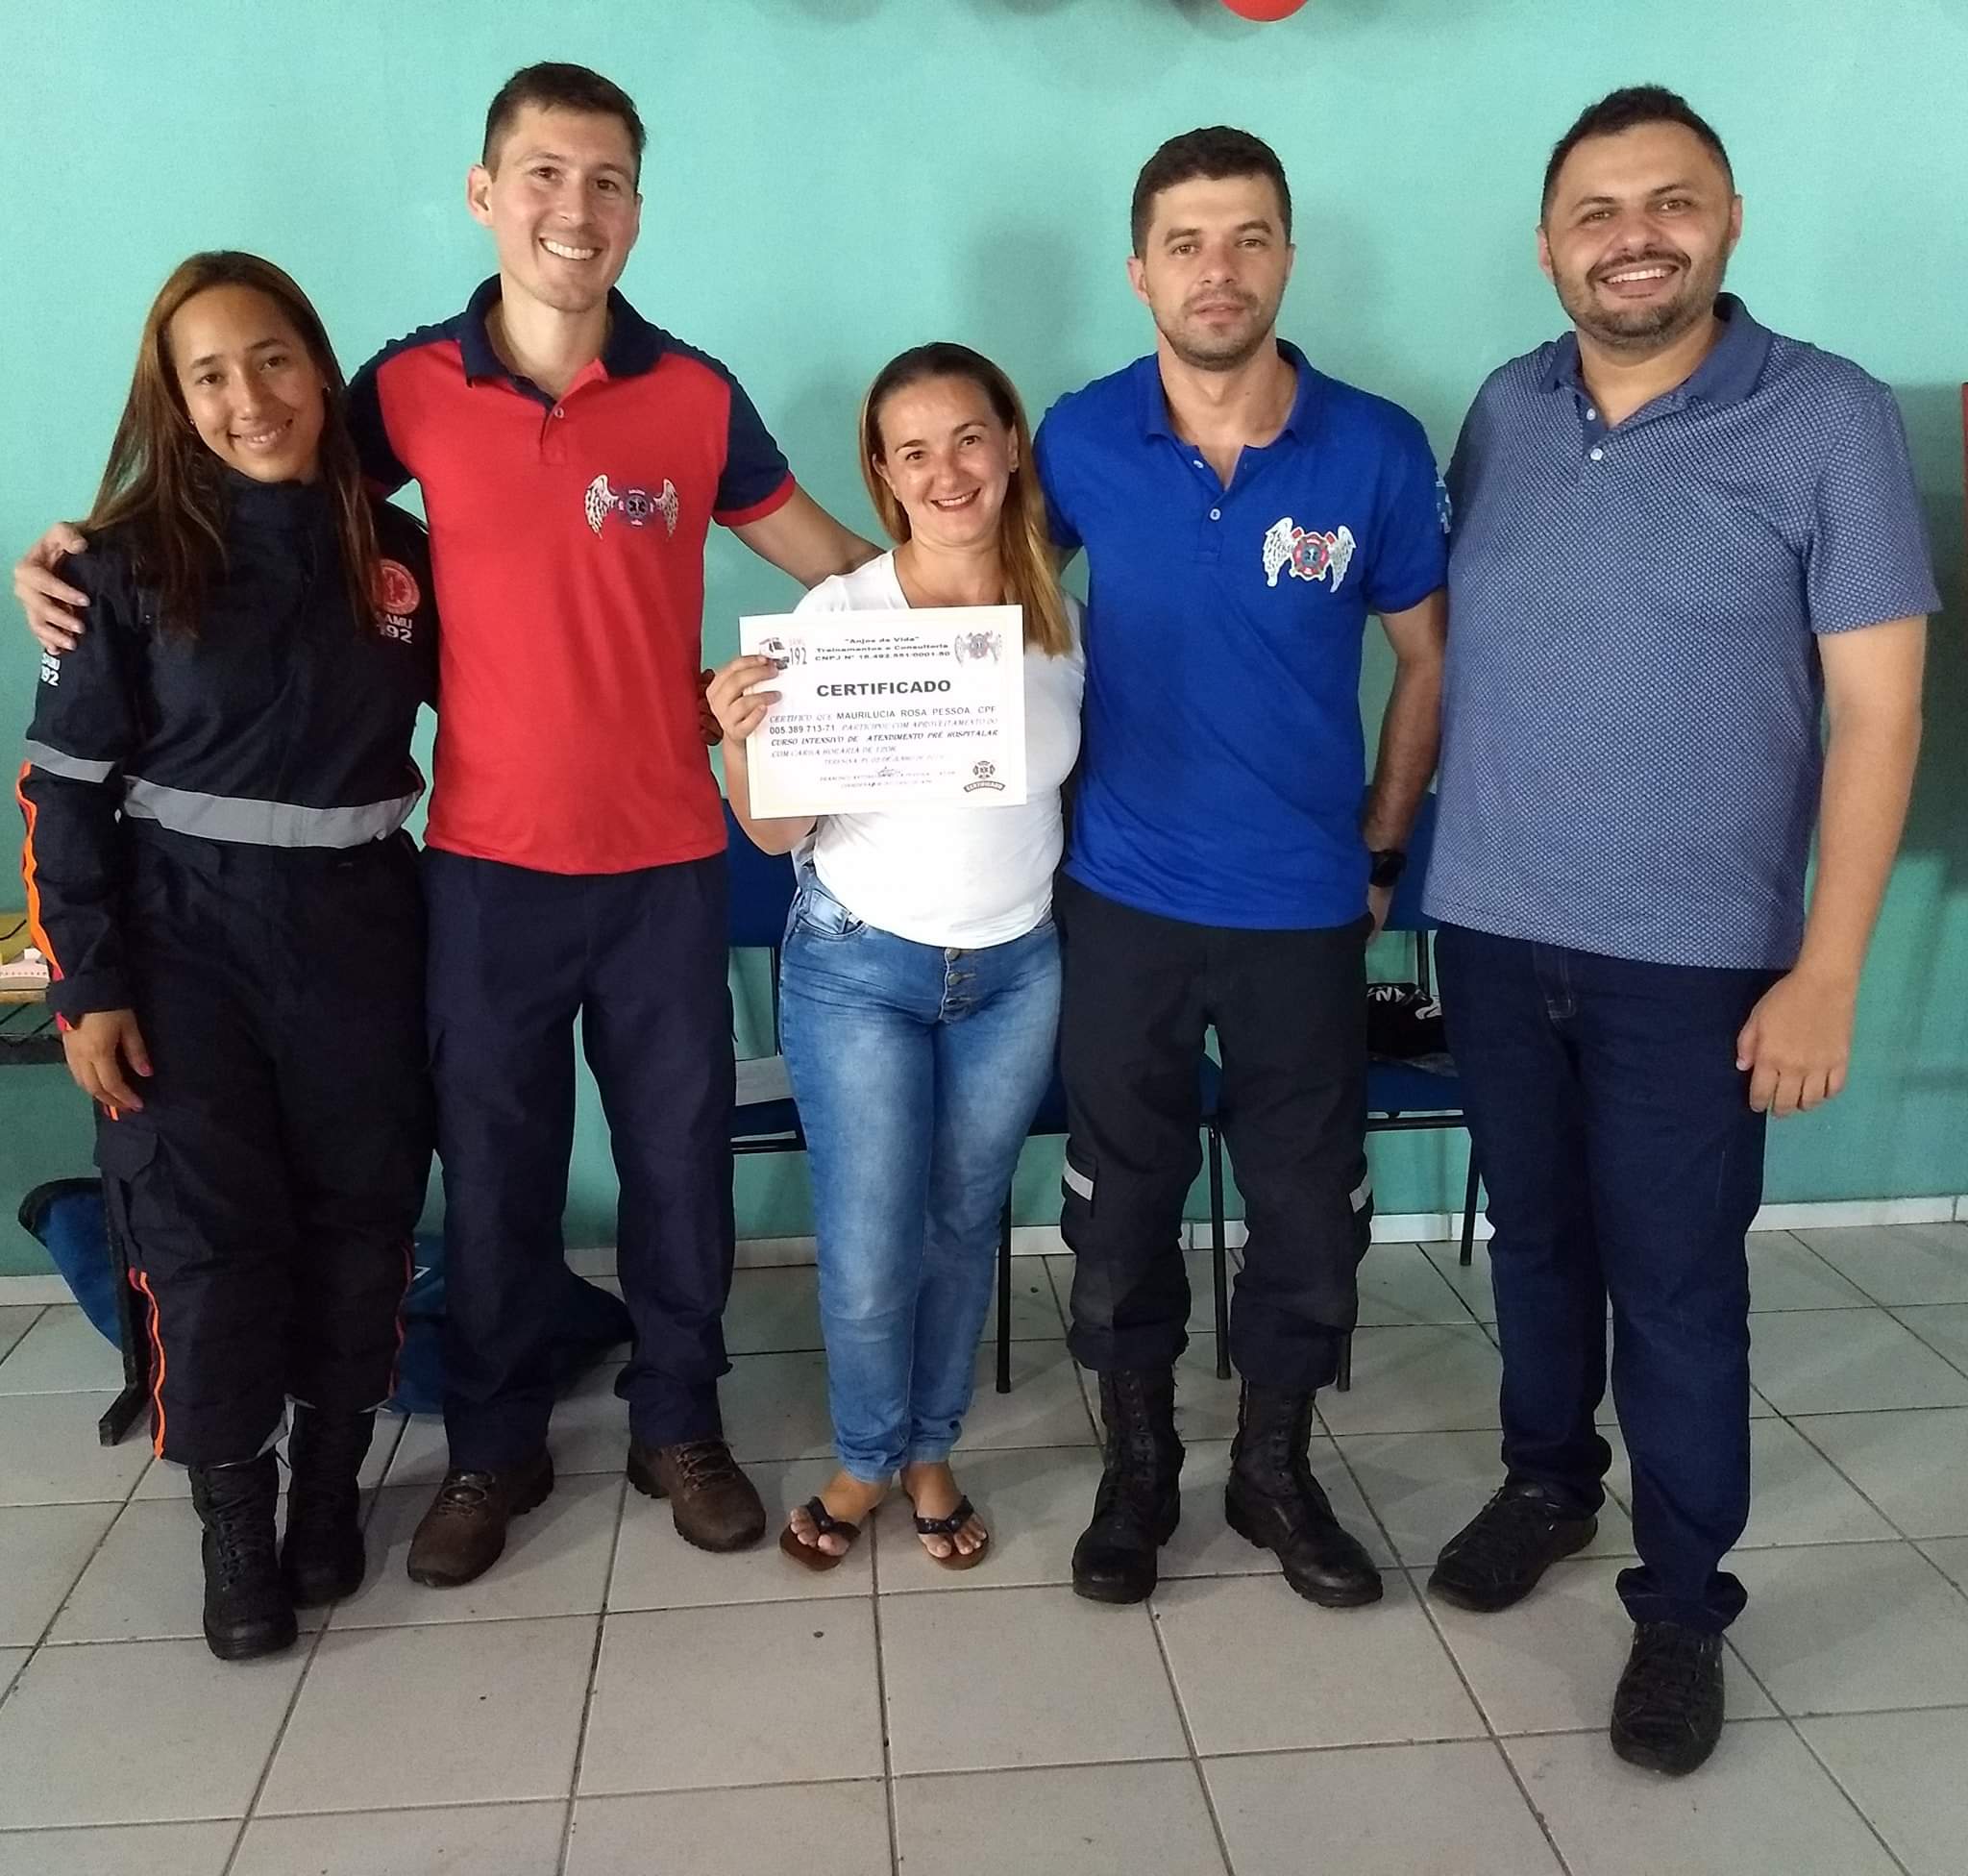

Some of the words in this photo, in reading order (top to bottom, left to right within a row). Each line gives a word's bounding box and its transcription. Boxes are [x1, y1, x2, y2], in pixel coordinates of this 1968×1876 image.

[790, 647, 807, 665] 192
[816, 679, 951, 697] CERTIFICADO
[837, 710, 896, 720] MAURILUCIA
[932, 706, 971, 715] PESSOA
[977, 705, 996, 714] CPF
[771, 738, 798, 747] CURSO
[801, 736, 844, 745] INTENSIVO
[867, 732, 924, 742] ATENDIMENTO
[947, 729, 998, 738] HOSPITALAR
